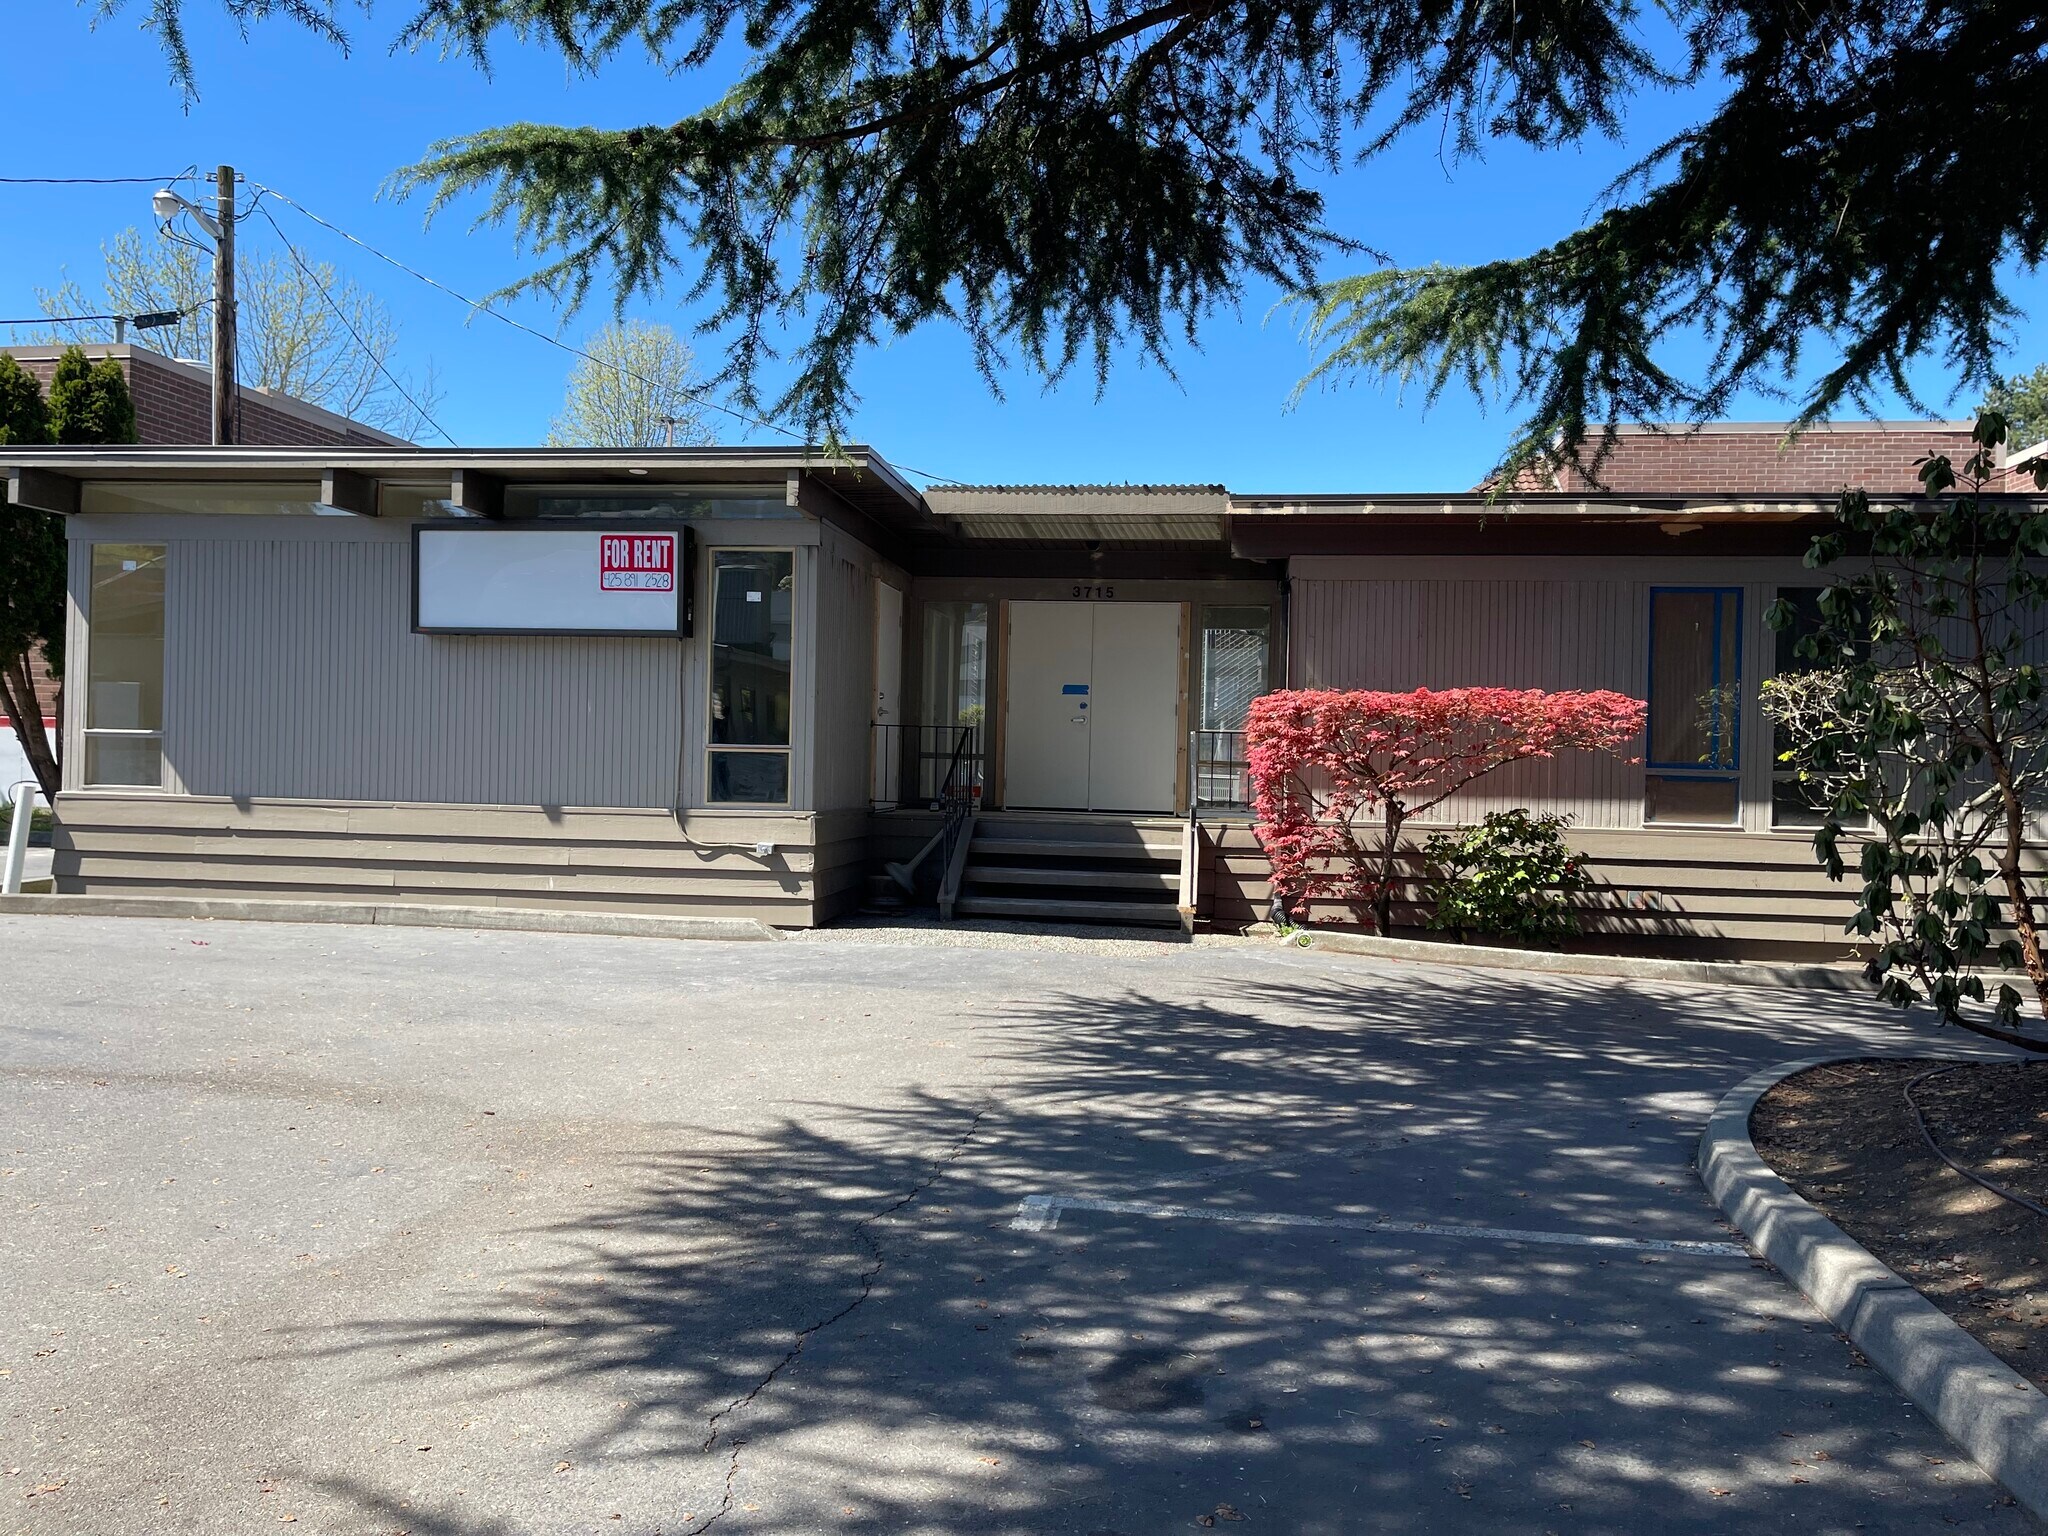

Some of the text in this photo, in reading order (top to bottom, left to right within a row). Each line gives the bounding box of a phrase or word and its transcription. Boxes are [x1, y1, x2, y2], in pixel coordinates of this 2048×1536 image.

[604, 539, 670, 568] FOR RENT
[603, 573, 669, 587] 425 891 2528
[1072, 586, 1114, 598] 3715
